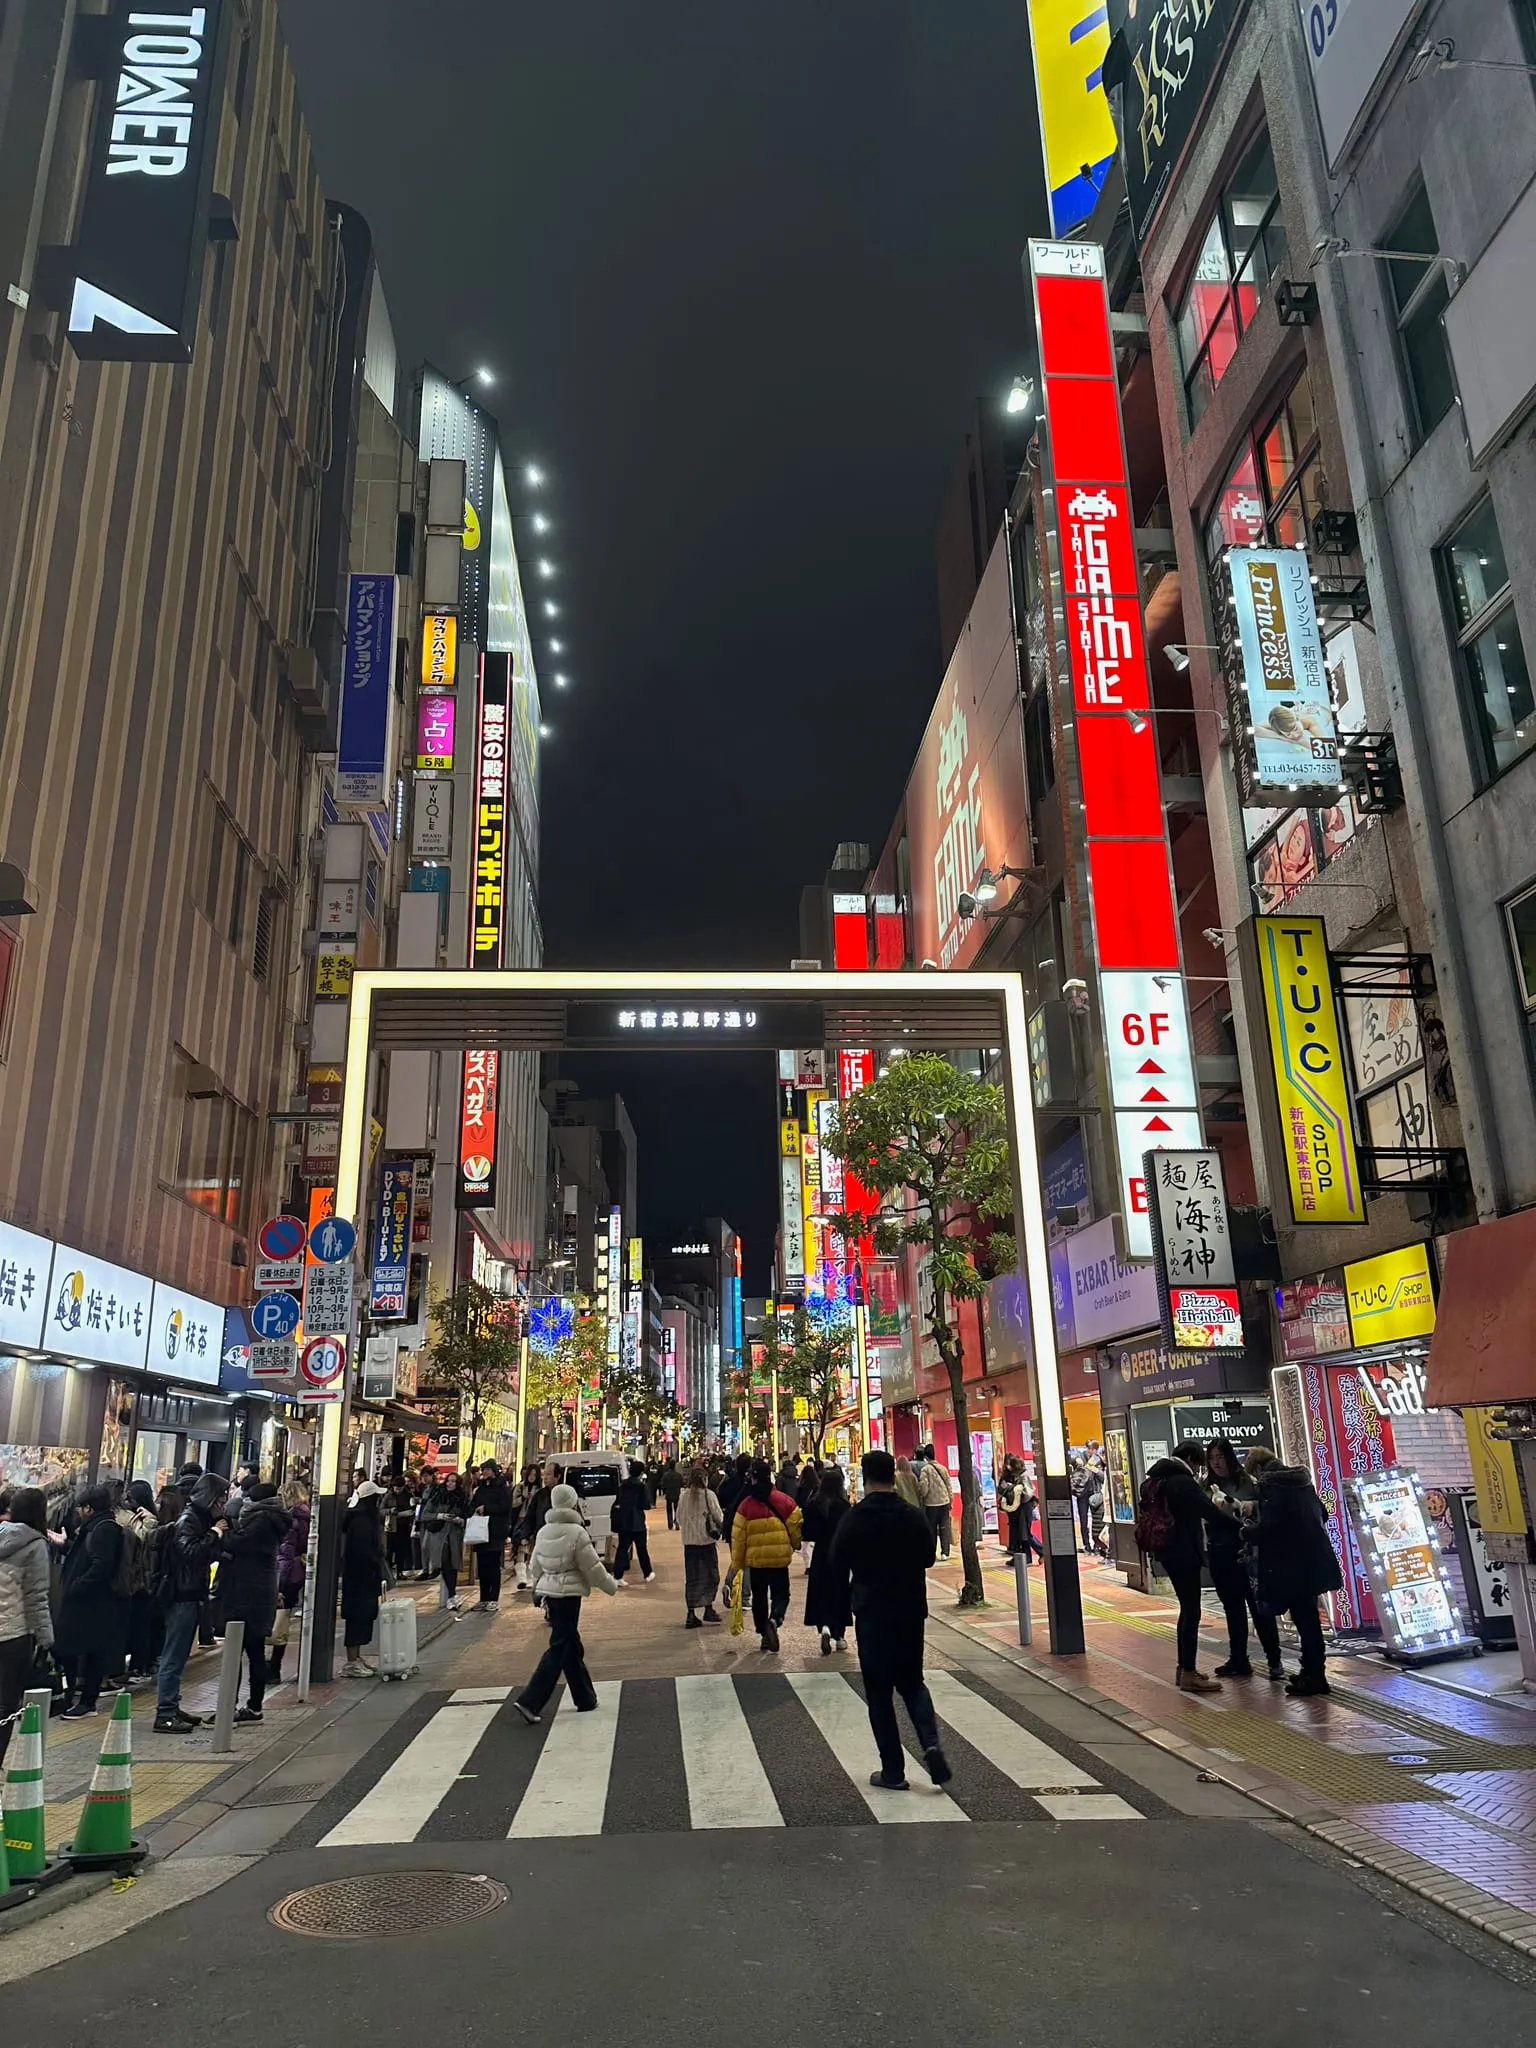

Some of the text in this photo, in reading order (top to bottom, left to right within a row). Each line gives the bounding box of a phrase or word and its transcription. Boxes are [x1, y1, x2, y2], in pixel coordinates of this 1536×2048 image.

[105, 7, 207, 177] TOWER
[1035, 245, 1092, 261] ワールド
[1069, 262, 1098, 276] ビル
[1070, 523, 1097, 704] TAITO STATION
[1083, 523, 1133, 705] GAME
[1251, 573, 1283, 682] Princess
[1289, 565, 1321, 688] リフレッシュ 新宿店
[352, 580, 376, 689] アパマンショップ
[430, 617, 448, 683] タウンハウジング
[1275, 631, 1293, 680] プリンセス
[424, 720, 450, 752] 占い
[482, 703, 506, 798] 驚安の殿堂
[1311, 737, 1335, 760] 3F
[425, 784, 440, 831] WINQLE
[475, 803, 503, 950] ドン・キホーテ
[617, 1011, 757, 1028] 新宿武蔵野通り
[1122, 1012, 1171, 1046] 6F
[803, 1074, 816, 1083] 5F
[1161, 1158, 1218, 1191] 麺屋
[1288, 1106, 1317, 1211] 新宿駅東南口店
[1312, 1123, 1334, 1193] SHOP
[828, 1192, 844, 1204] 2F
[1212, 1195, 1225, 1234] あら炊き
[1175, 1195, 1217, 1280] 海神
[1167, 1237, 1182, 1276] らーめん
[375, 1283, 403, 1293] 新宿店
[1075, 1258, 1108, 1297] EXBAR
[1403, 1283, 1423, 1296] SHOP
[86, 1288, 143, 1337] 焼きいも
[387, 1294, 404, 1311] B1
[1176, 1305, 1236, 1325] Highball
[1181, 1293, 1218, 1308] Pizza
[262, 1304, 282, 1335] P
[274, 1320, 289, 1335] 40
[185, 1320, 208, 1356] 抹茶
[311, 1350, 338, 1371] 30
[1131, 1348, 1160, 1379] BEER
[438, 1434, 458, 1446] 6F
[1183, 1426, 1221, 1438] EXBAR
